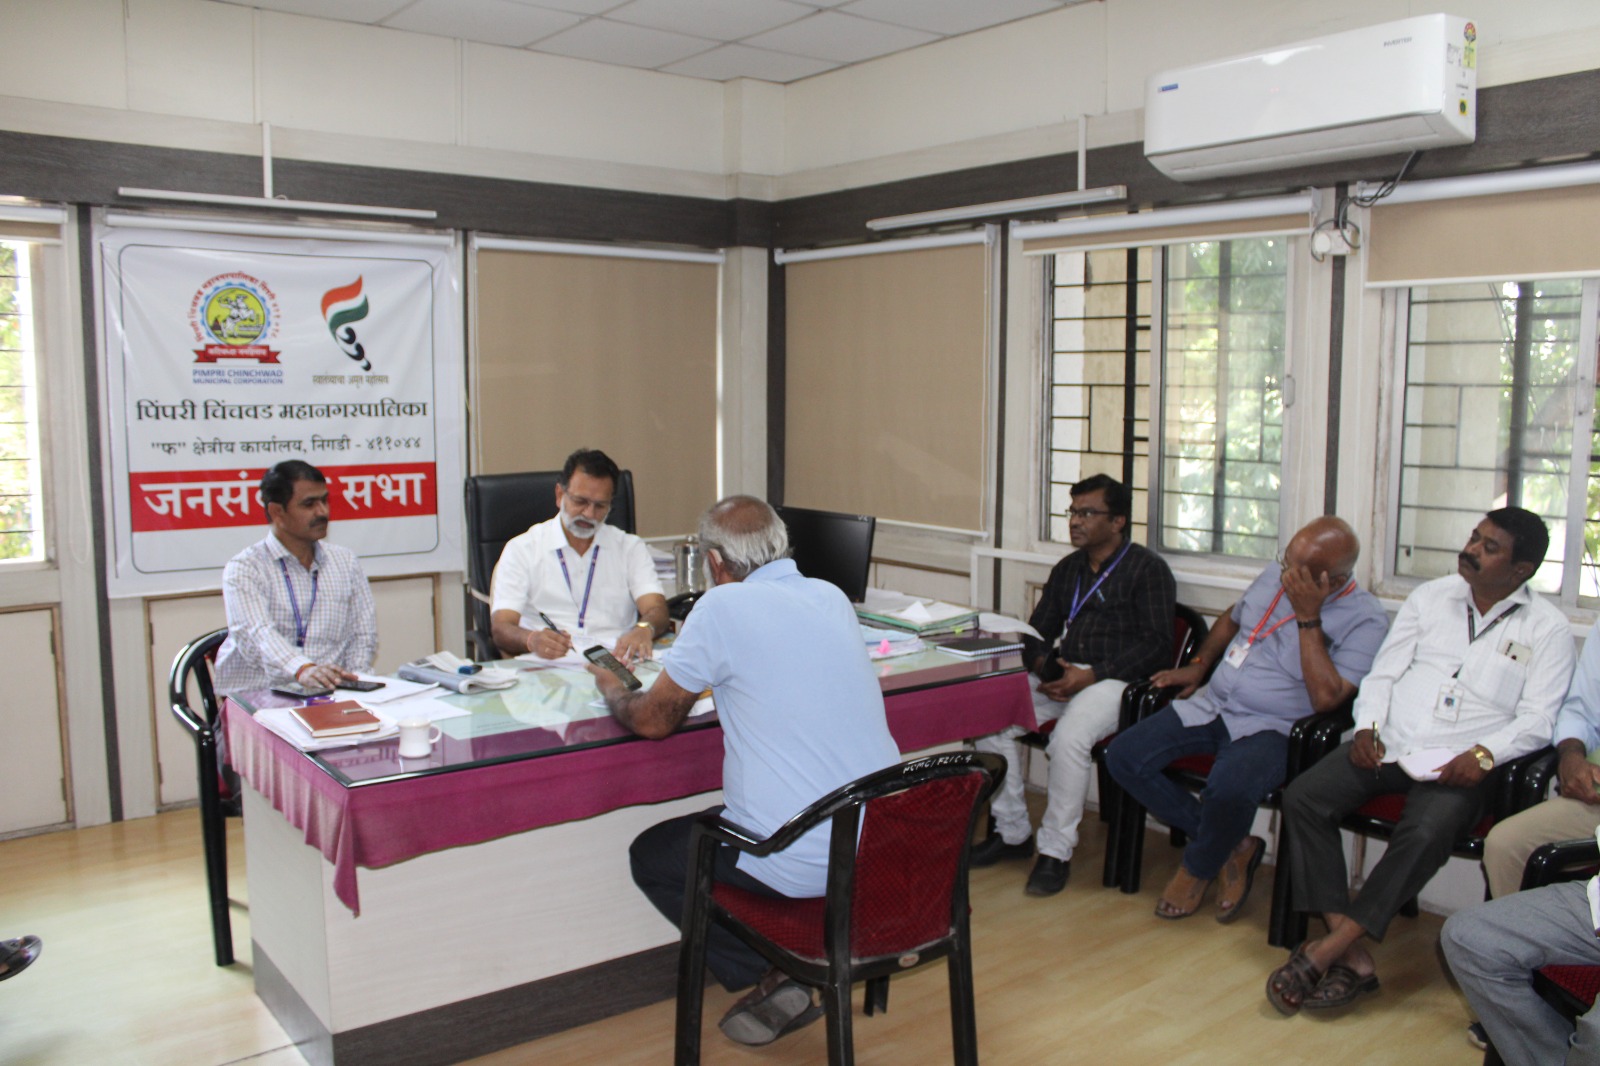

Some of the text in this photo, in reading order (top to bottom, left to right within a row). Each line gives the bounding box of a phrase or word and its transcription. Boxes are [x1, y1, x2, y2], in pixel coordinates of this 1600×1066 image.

[193, 369, 283, 377] PIMPRI CHINCHWAD
[136, 397, 427, 420] पिंपरी चिंचवड महानगरपालिका
[192, 437, 236, 456] क्षेत्रीय
[239, 435, 307, 454] कार्यालय,
[311, 434, 351, 452] निगडी
[365, 436, 421, 451] ४११०४४
[338, 473, 427, 511] सभा
